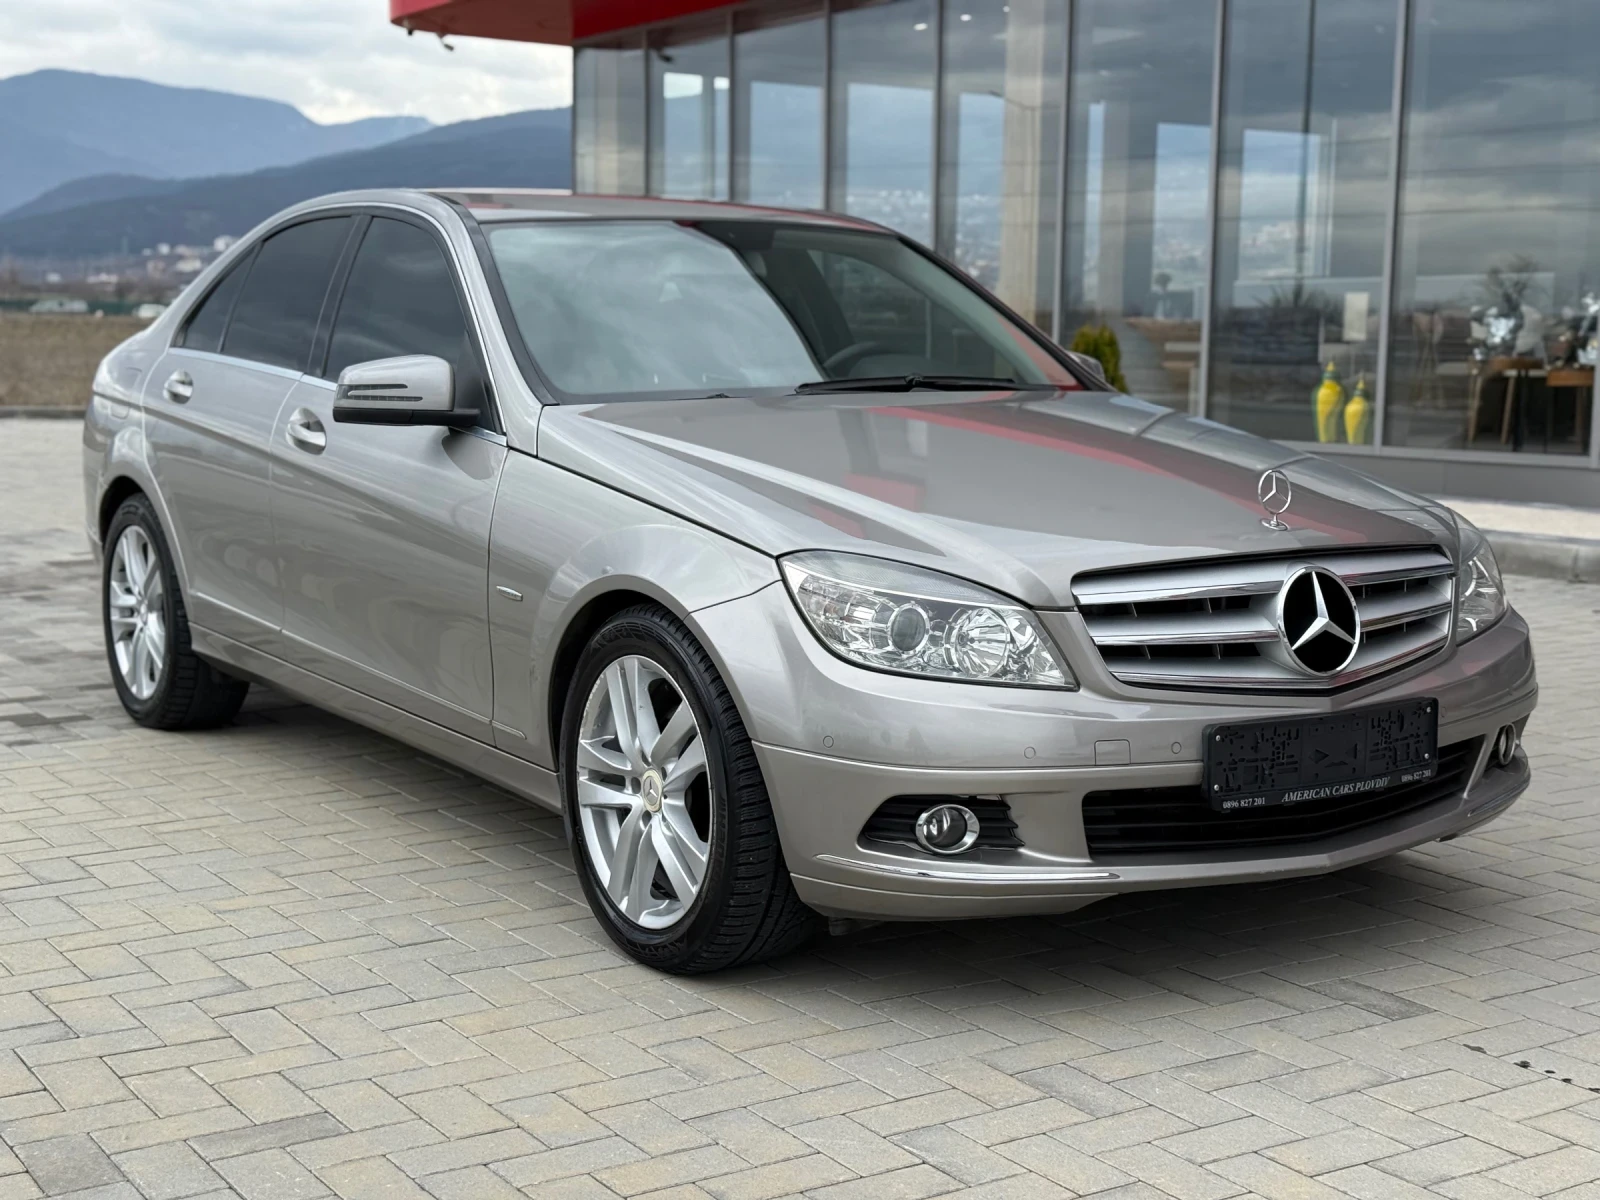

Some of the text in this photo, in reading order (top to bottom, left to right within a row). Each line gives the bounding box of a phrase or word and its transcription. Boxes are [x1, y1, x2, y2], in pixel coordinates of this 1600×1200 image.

[1282, 777, 1390, 802] AMERICAN CARS PLOVDIV
[1223, 797, 1265, 809] 0896 827 201
